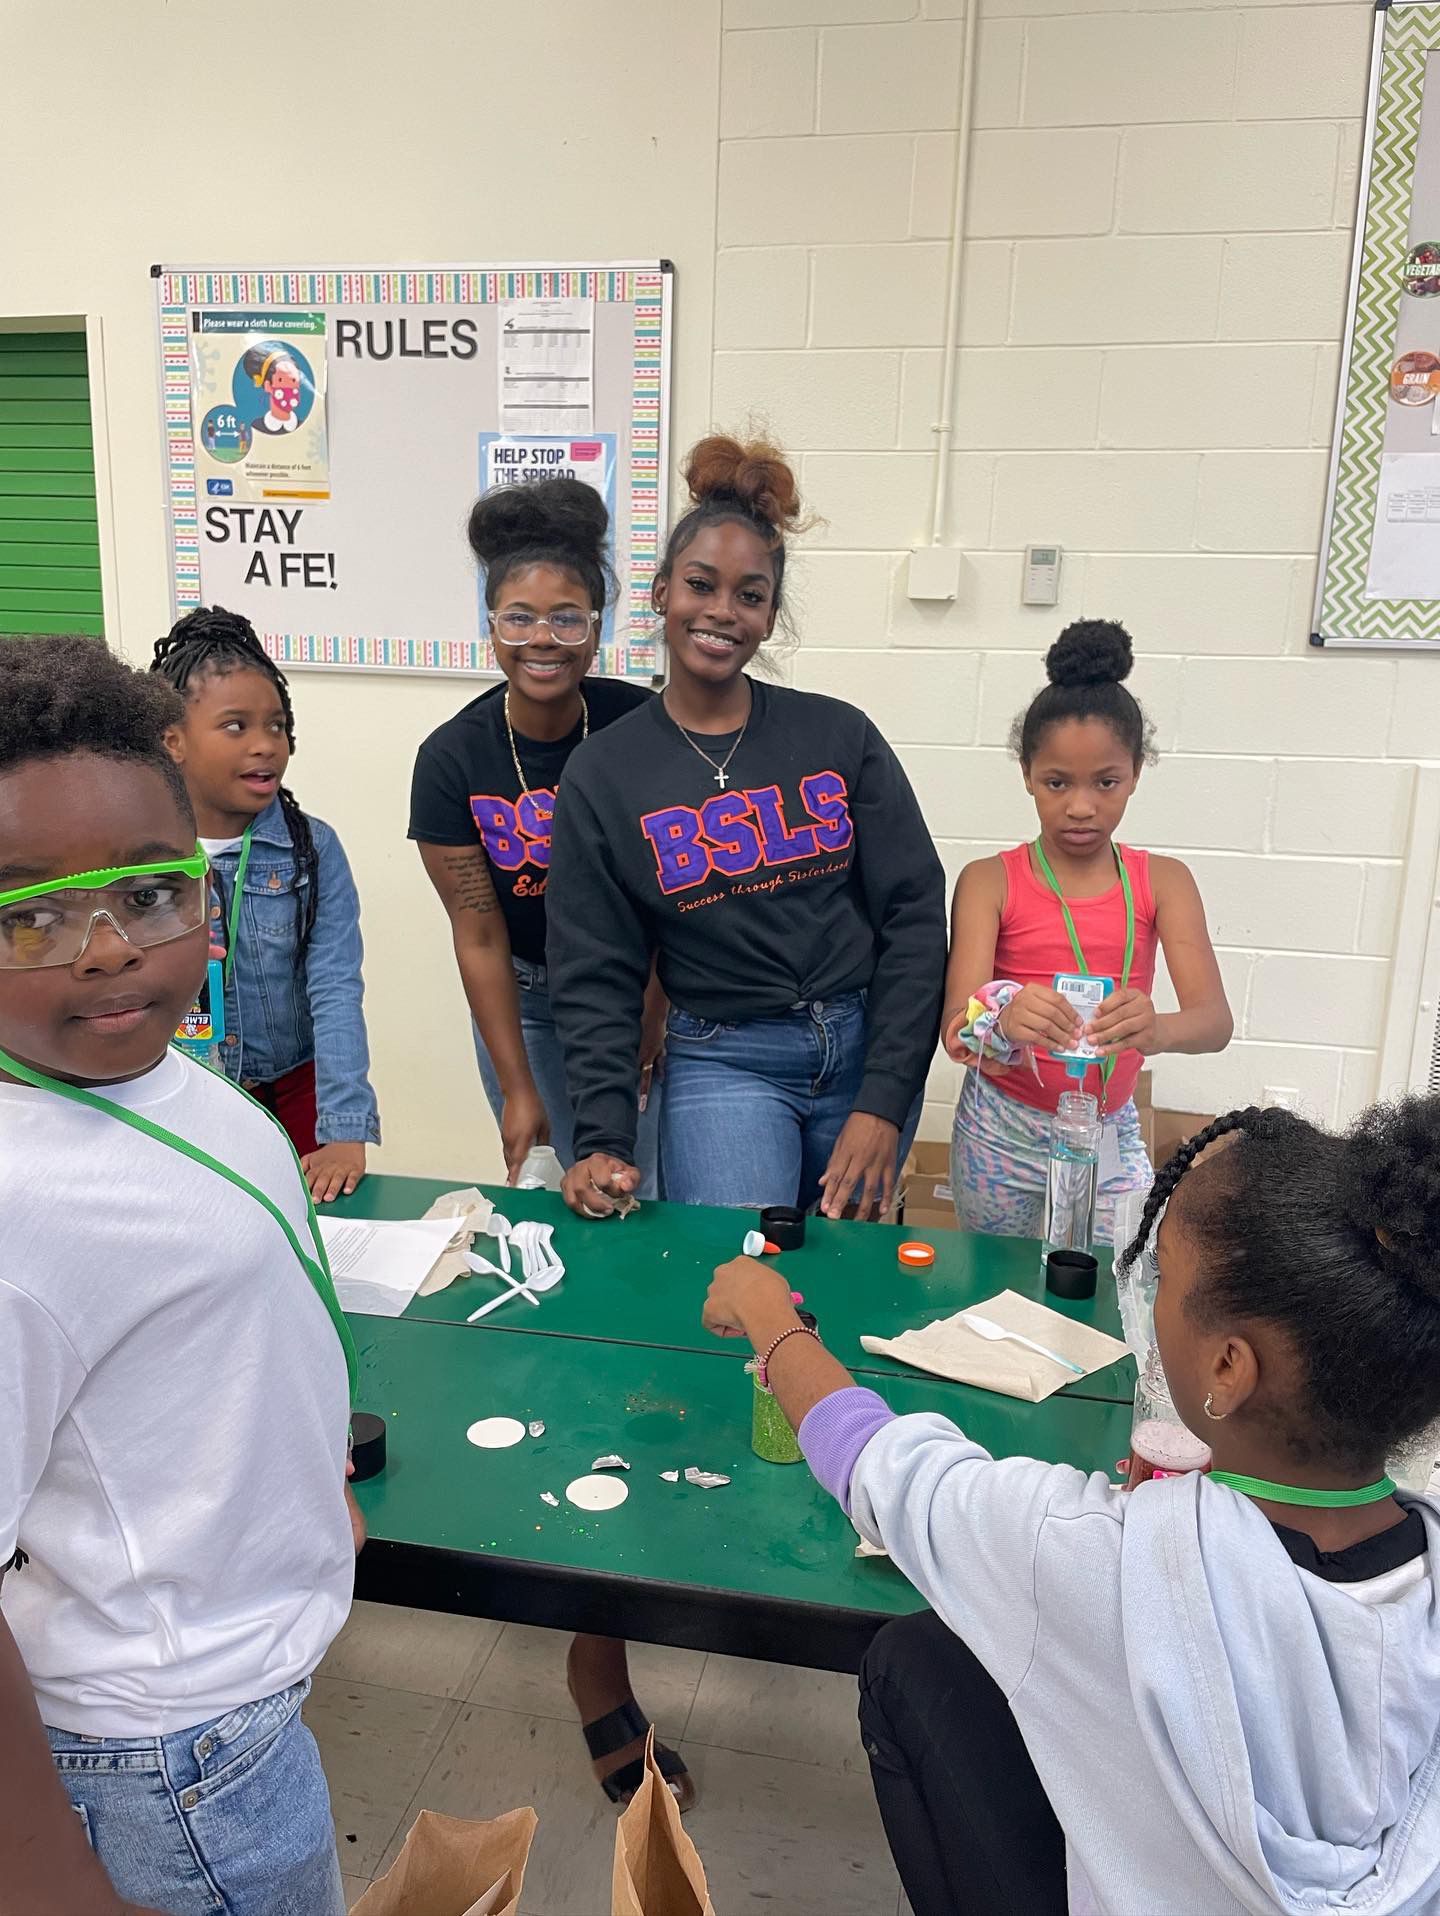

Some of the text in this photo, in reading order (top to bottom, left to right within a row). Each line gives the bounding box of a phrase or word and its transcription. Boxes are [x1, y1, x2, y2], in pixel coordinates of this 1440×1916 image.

[203, 318, 317, 331] Please wear a cloth face covering.
[336, 318, 478, 360] RULES
[217, 414, 236, 428] 6 ft
[494, 447, 527, 464] HELP
[531, 448, 565, 464] STOP
[494, 467, 576, 484] THE SPREAD
[205, 506, 303, 544] STAY
[470, 785, 559, 871] BS
[640, 770, 854, 895] BSLS
[677, 858, 849, 912] Success through Sisterhood
